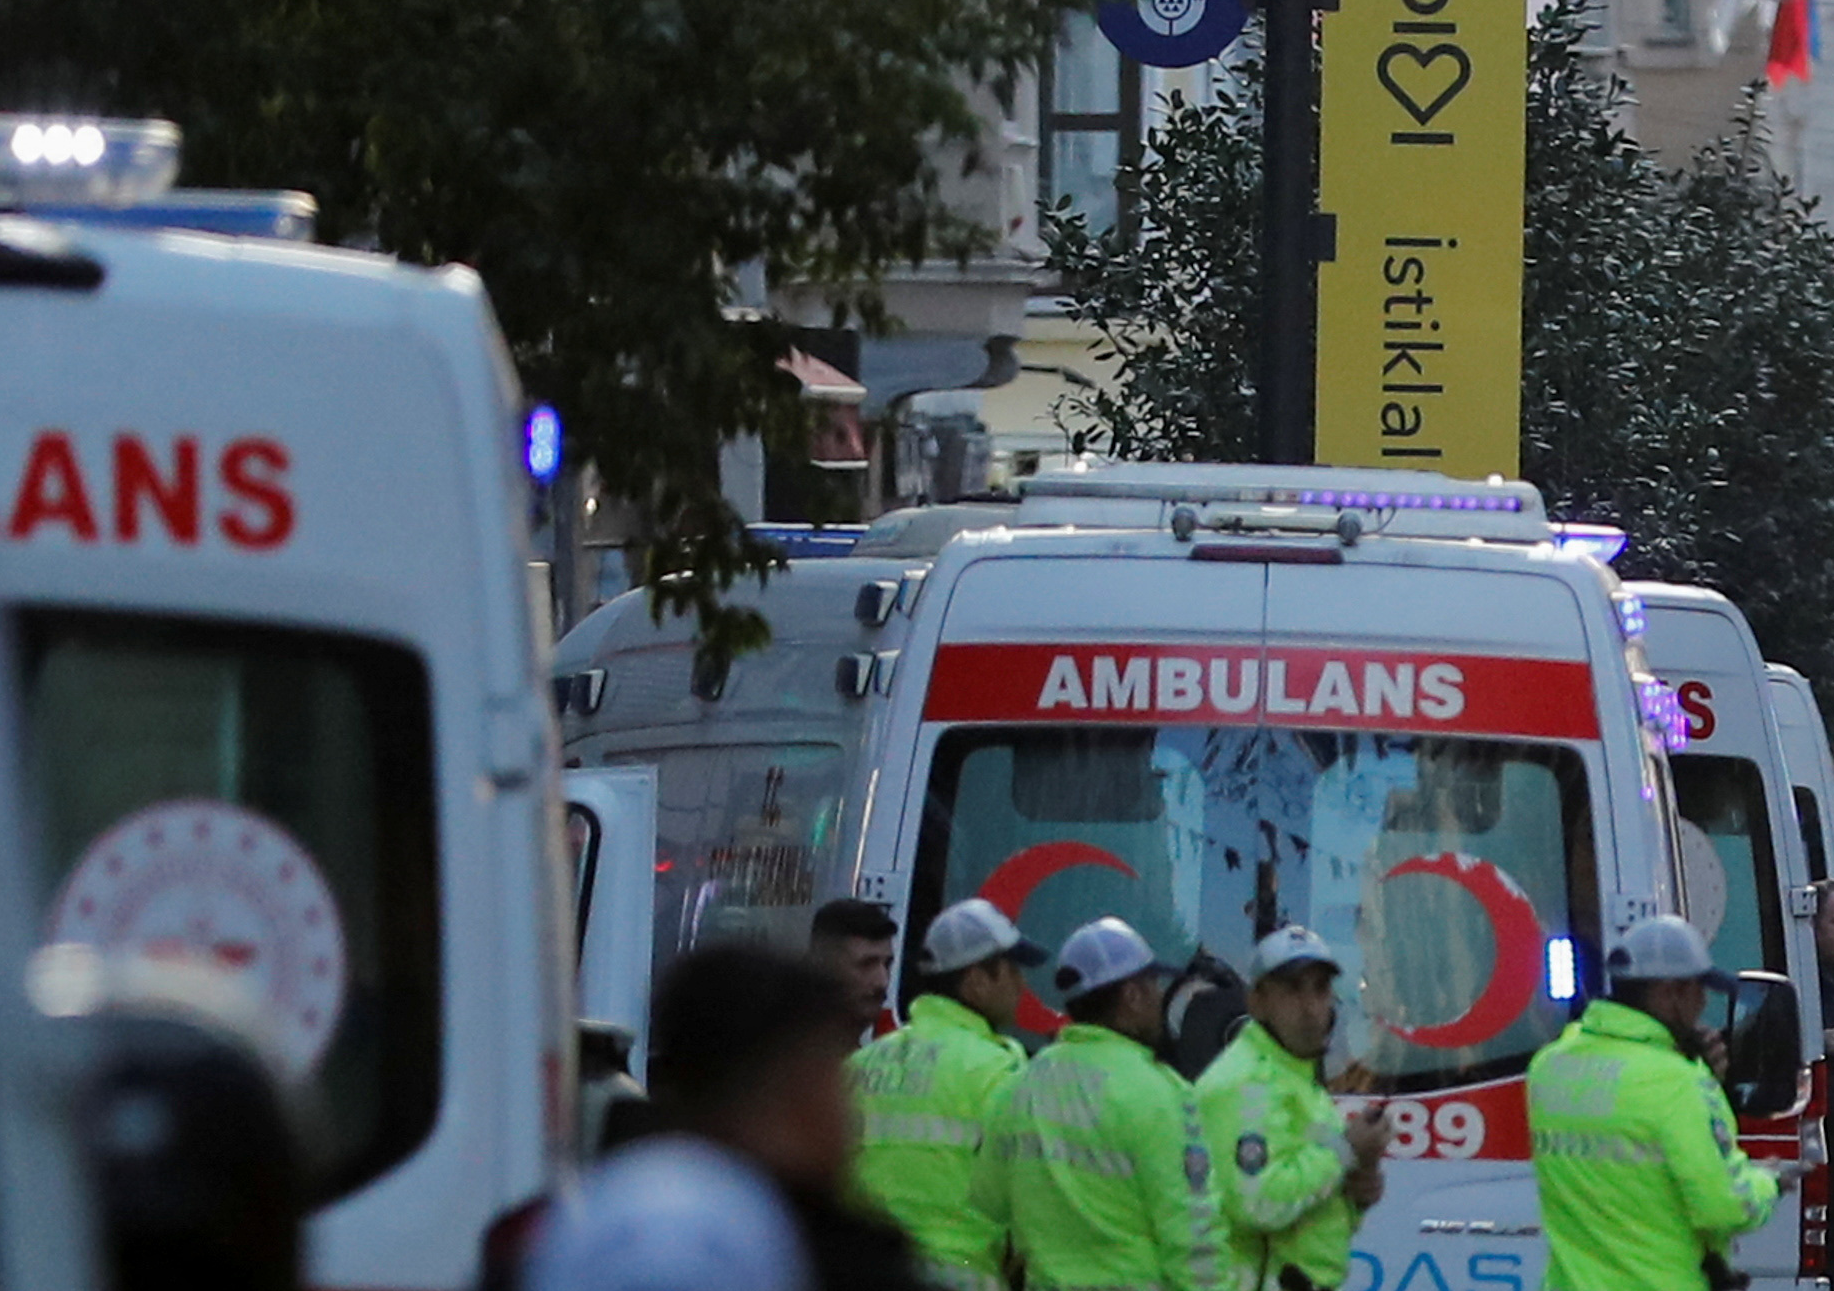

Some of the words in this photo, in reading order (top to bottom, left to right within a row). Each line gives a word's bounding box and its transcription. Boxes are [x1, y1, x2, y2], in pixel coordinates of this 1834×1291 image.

[1380, 236, 1459, 459] istiklal
[1037, 656, 1465, 719] AMBULANS
[1339, 1098, 1485, 1159] 89
